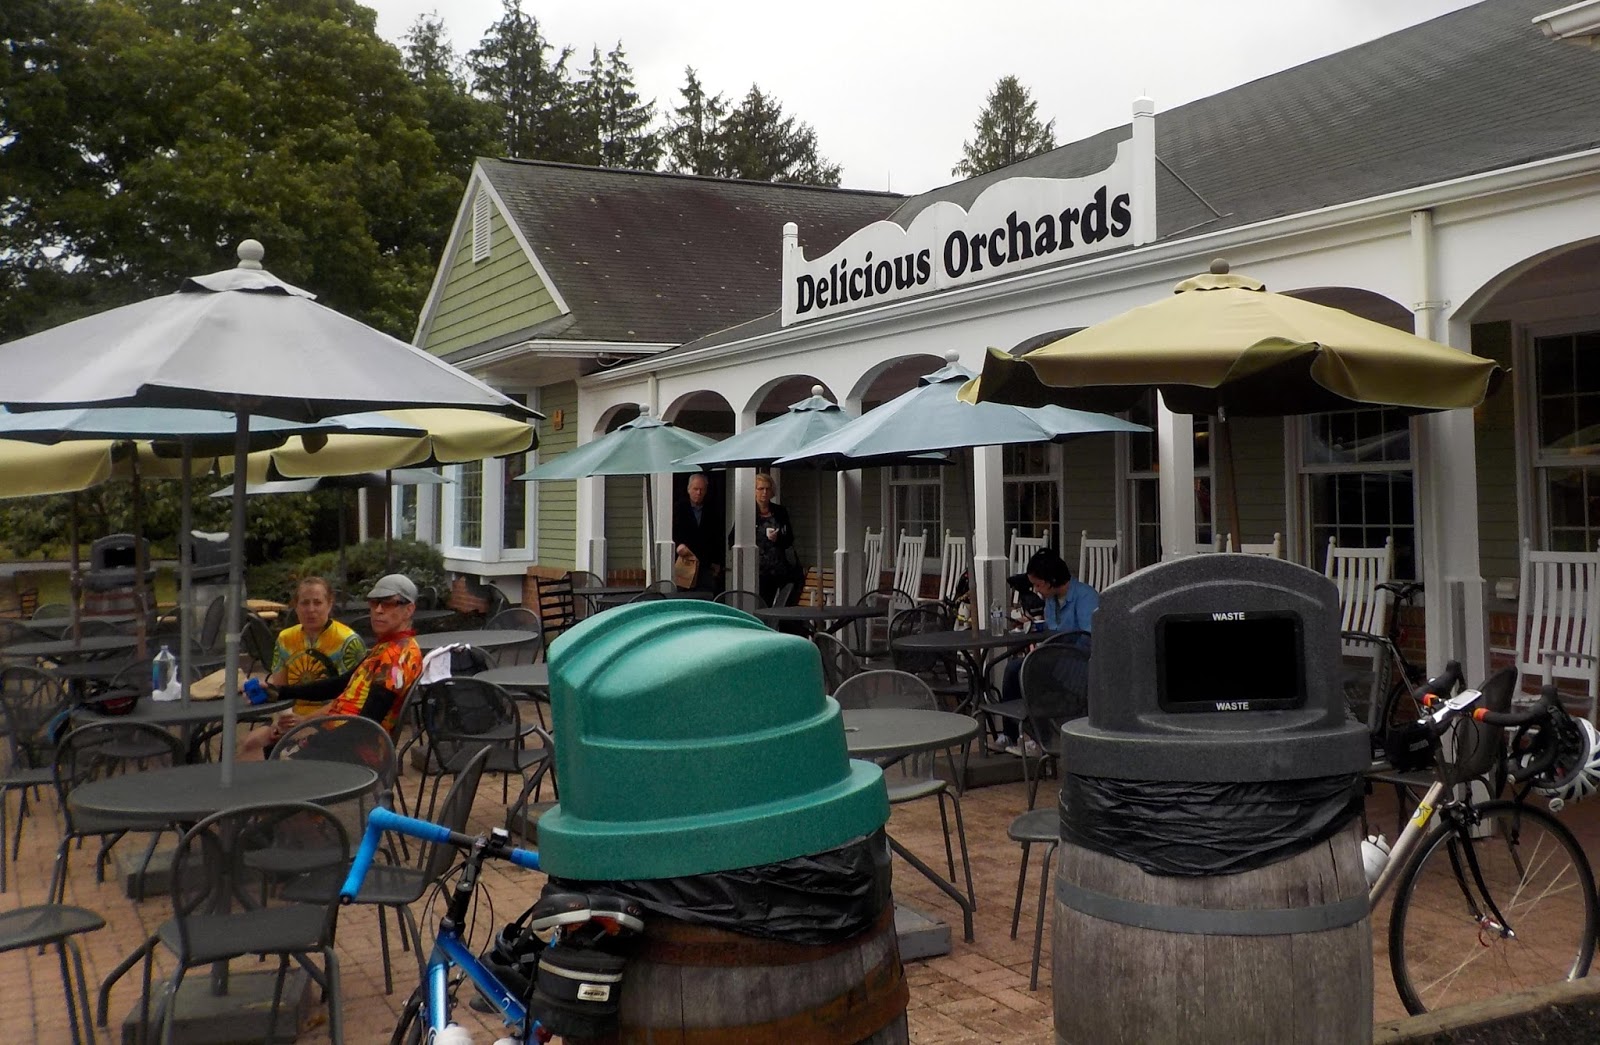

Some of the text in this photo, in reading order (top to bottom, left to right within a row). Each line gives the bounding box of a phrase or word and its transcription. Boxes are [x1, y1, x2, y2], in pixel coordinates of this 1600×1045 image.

[796, 185, 1132, 314] Delicious Orchards
[1212, 612, 1245, 621] WASTE
[1216, 702, 1249, 711] WASTE
